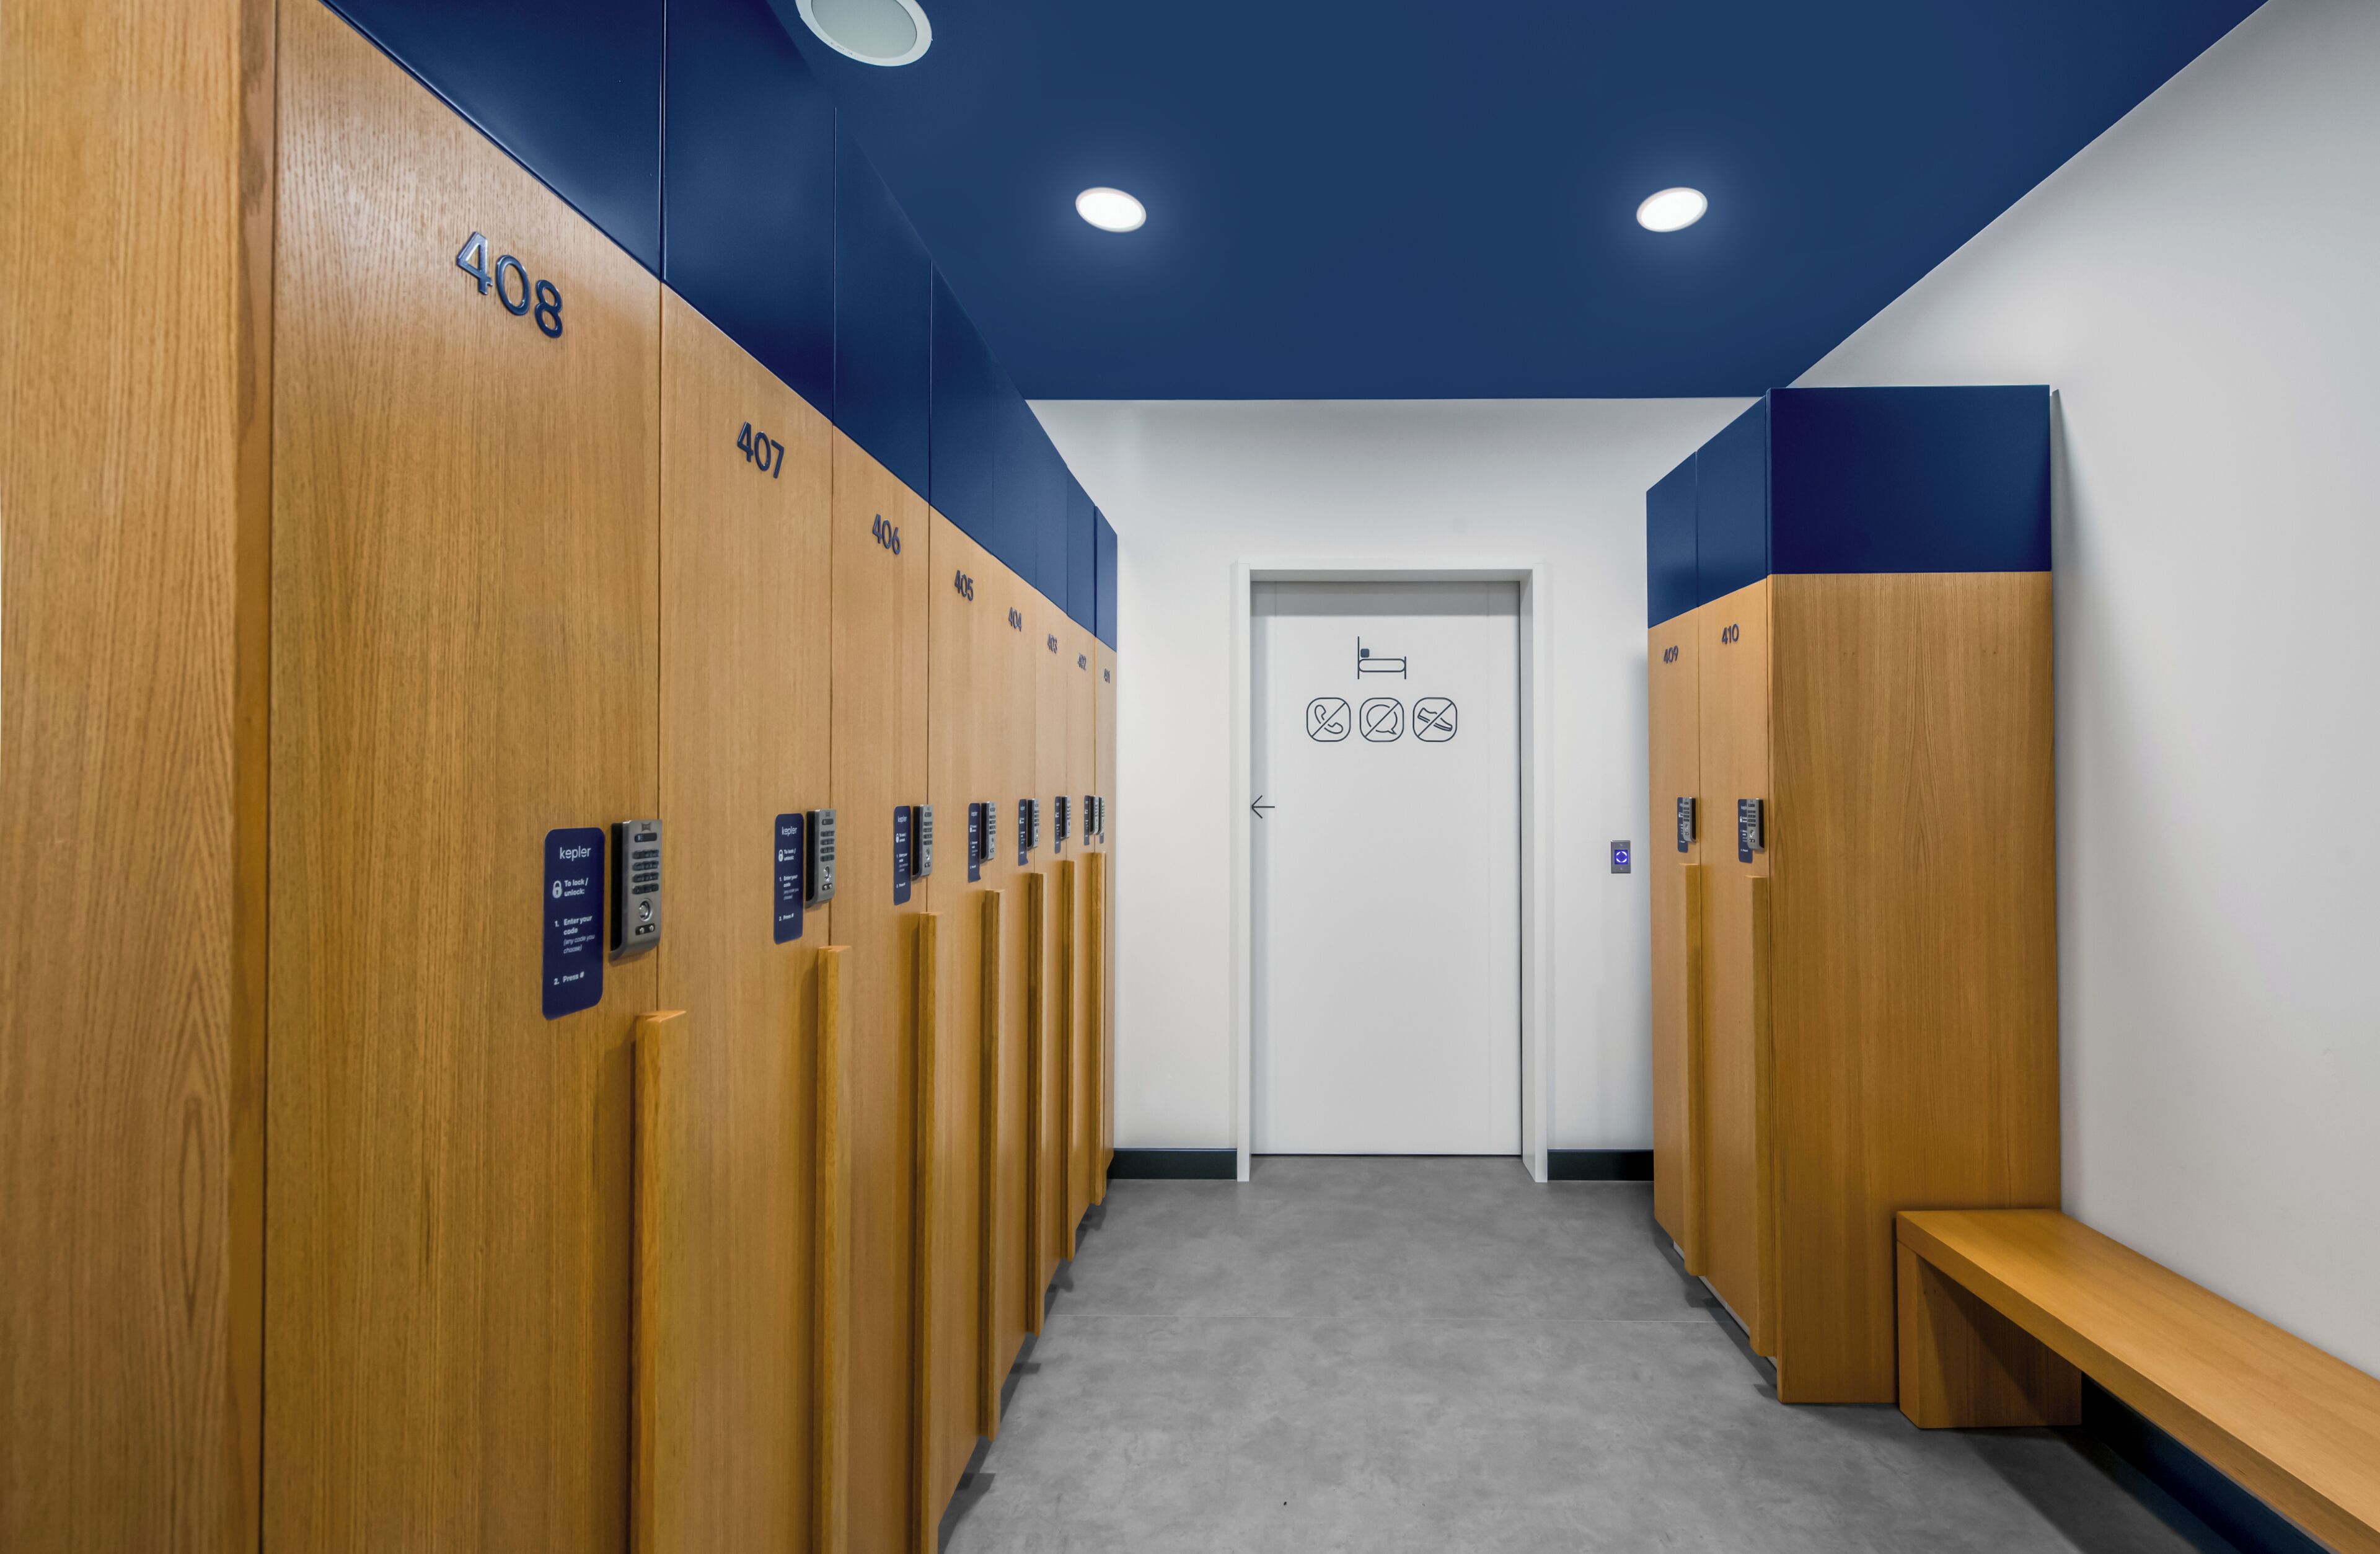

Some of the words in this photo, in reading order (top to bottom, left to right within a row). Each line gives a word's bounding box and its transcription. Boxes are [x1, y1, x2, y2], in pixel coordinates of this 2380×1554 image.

[456, 231, 563, 338] 408
[737, 422, 785, 479] 407
[873, 514, 901, 555] 406
[954, 570, 974, 601] 405
[1008, 607, 1022, 632] 404
[1047, 634, 1057, 654] 403
[1721, 624, 1739, 645] 410
[1664, 645, 1678, 664] 409
[782, 826, 798, 836] kepler
[560, 845, 591, 862] kepler
[573, 878, 584, 886] lock
[580, 916, 593, 924] your
[563, 927, 578, 935] code
[563, 974, 579, 983] Press
